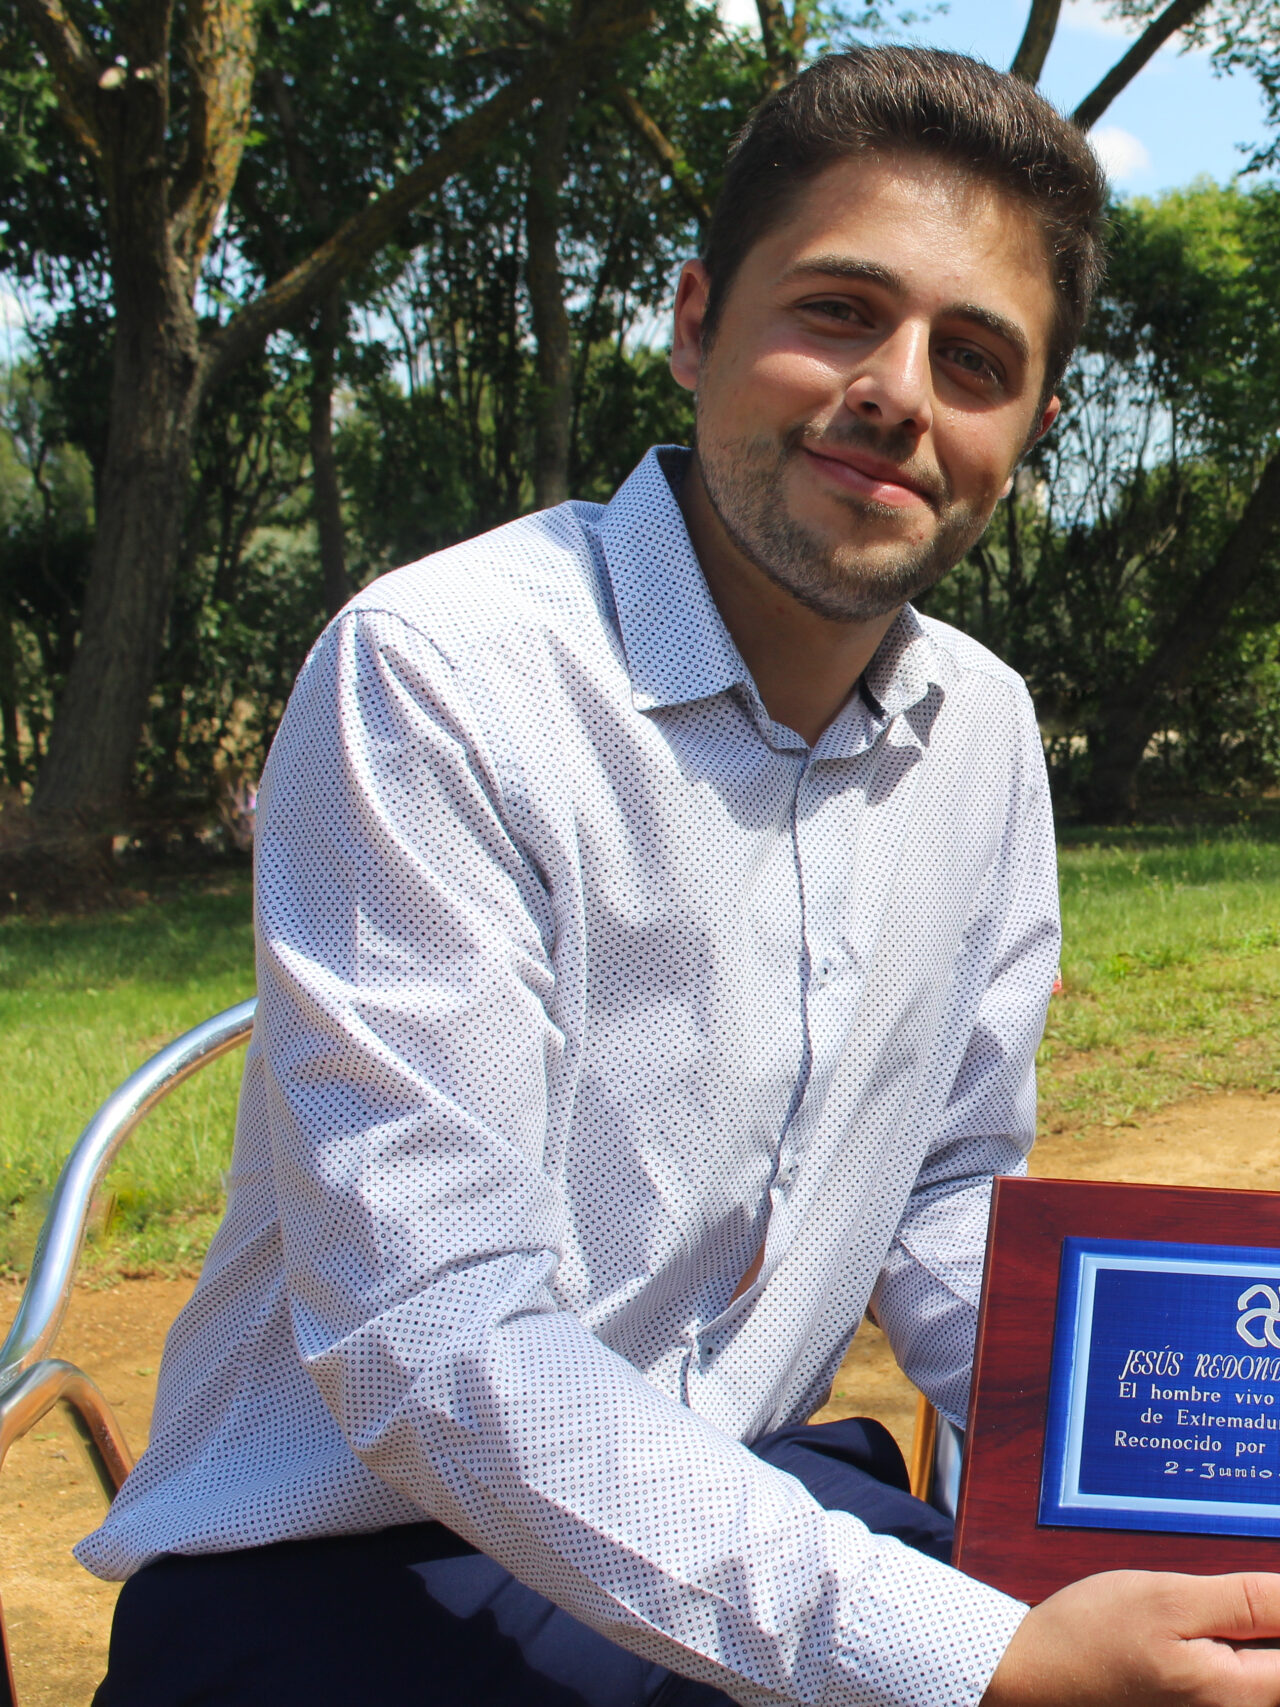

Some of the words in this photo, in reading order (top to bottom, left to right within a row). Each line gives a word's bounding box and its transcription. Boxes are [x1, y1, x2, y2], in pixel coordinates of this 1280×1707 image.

[1118, 1344, 1184, 1381] JESÚS
[1119, 1381, 1137, 1399] El
[1150, 1383, 1222, 1403] hombre
[1234, 1392, 1275, 1406] vivo
[1140, 1407, 1164, 1424] de
[1114, 1430, 1222, 1452] Reconocido
[1235, 1441, 1266, 1458] por
